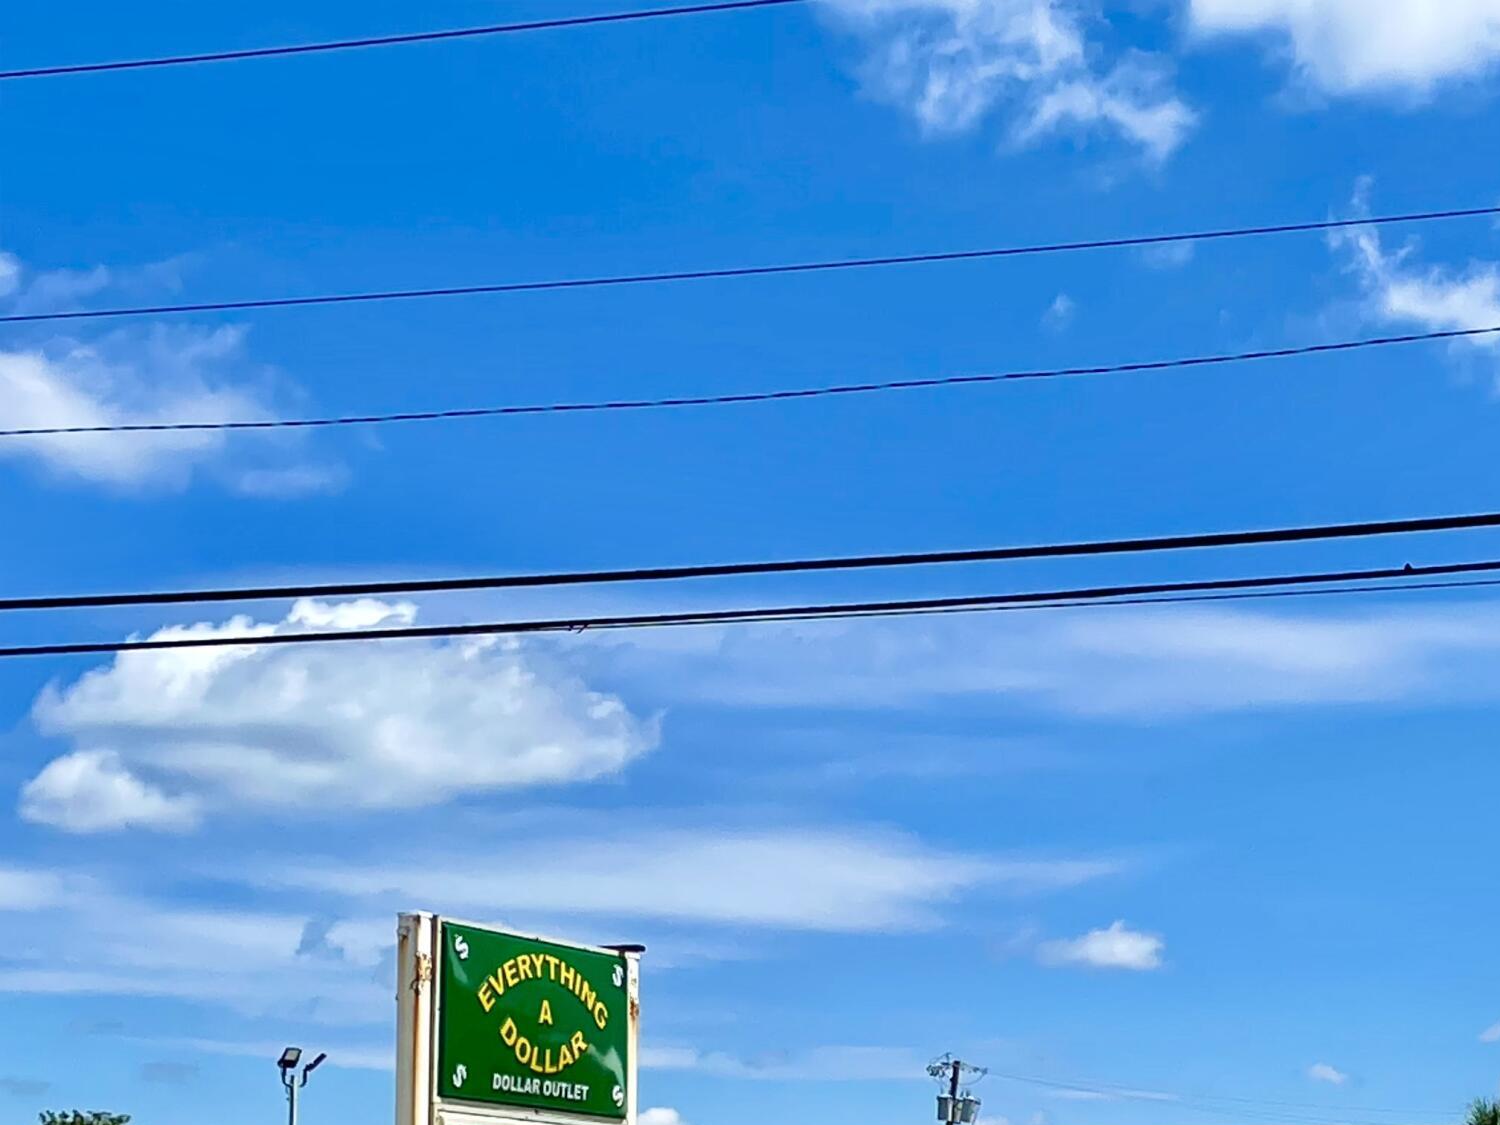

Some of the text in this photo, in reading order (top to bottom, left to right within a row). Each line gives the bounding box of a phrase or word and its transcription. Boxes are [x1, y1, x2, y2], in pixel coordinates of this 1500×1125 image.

[477, 953, 608, 1030] EVERYTHING
[538, 999, 553, 1025] A
[500, 1017, 588, 1073] DOLLAR
[492, 1073, 589, 1101] DOLLAR OUTLET
